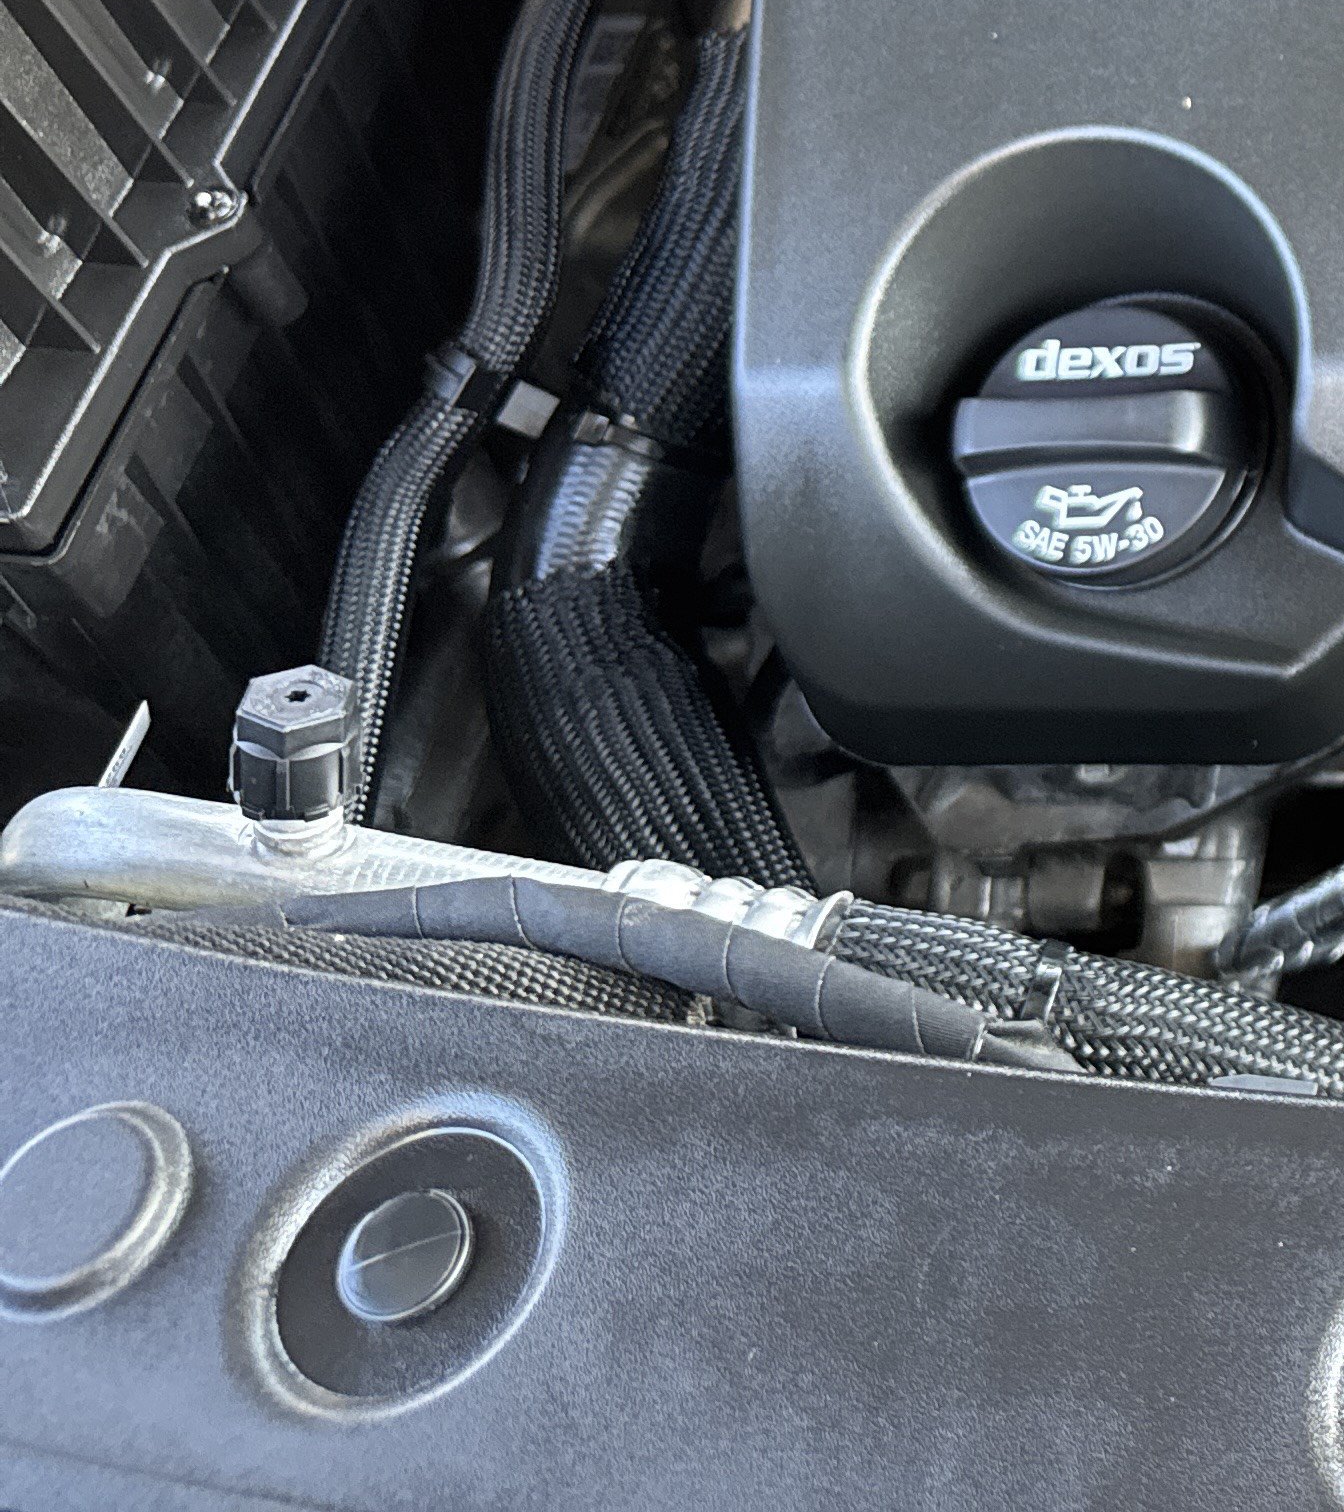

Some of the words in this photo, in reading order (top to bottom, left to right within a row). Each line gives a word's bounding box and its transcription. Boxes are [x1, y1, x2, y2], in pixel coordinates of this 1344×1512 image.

[1017, 338, 1201, 381] dexos
[1013, 519, 1070, 562] SAE
[1070, 516, 1164, 565] 5W-30
